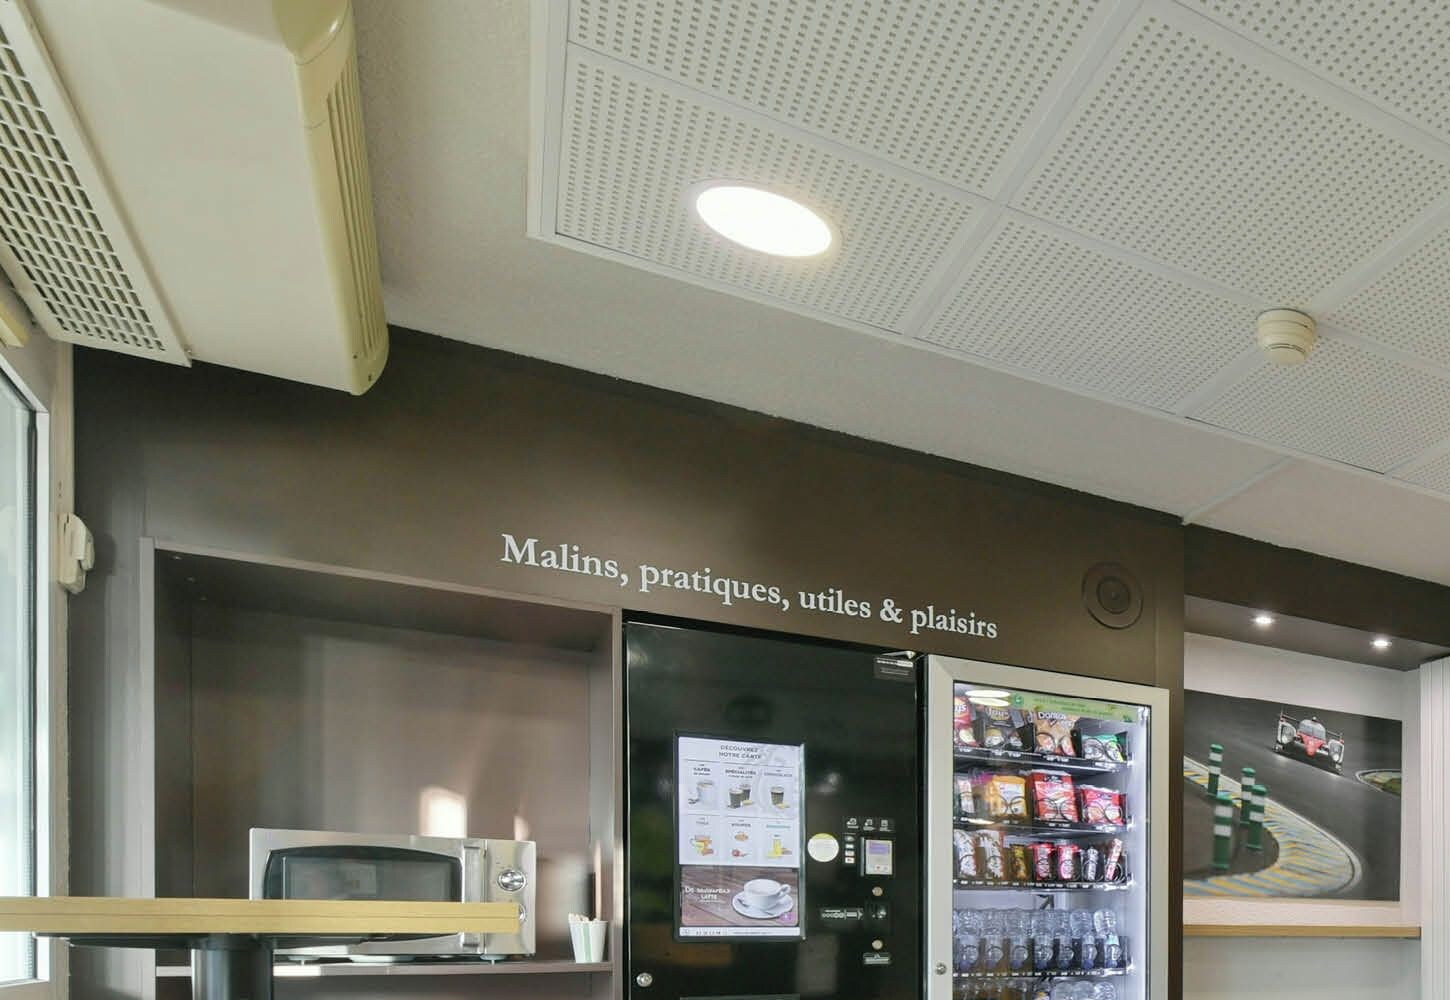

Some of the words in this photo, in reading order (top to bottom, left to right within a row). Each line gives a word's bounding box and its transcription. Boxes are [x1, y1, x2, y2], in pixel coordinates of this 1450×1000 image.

[500, 533, 629, 587] Malins,
[639, 560, 790, 613] pratiques,
[799, 587, 872, 618] utiles
[879, 598, 904, 624] &
[910, 605, 998, 639] plaisirs
